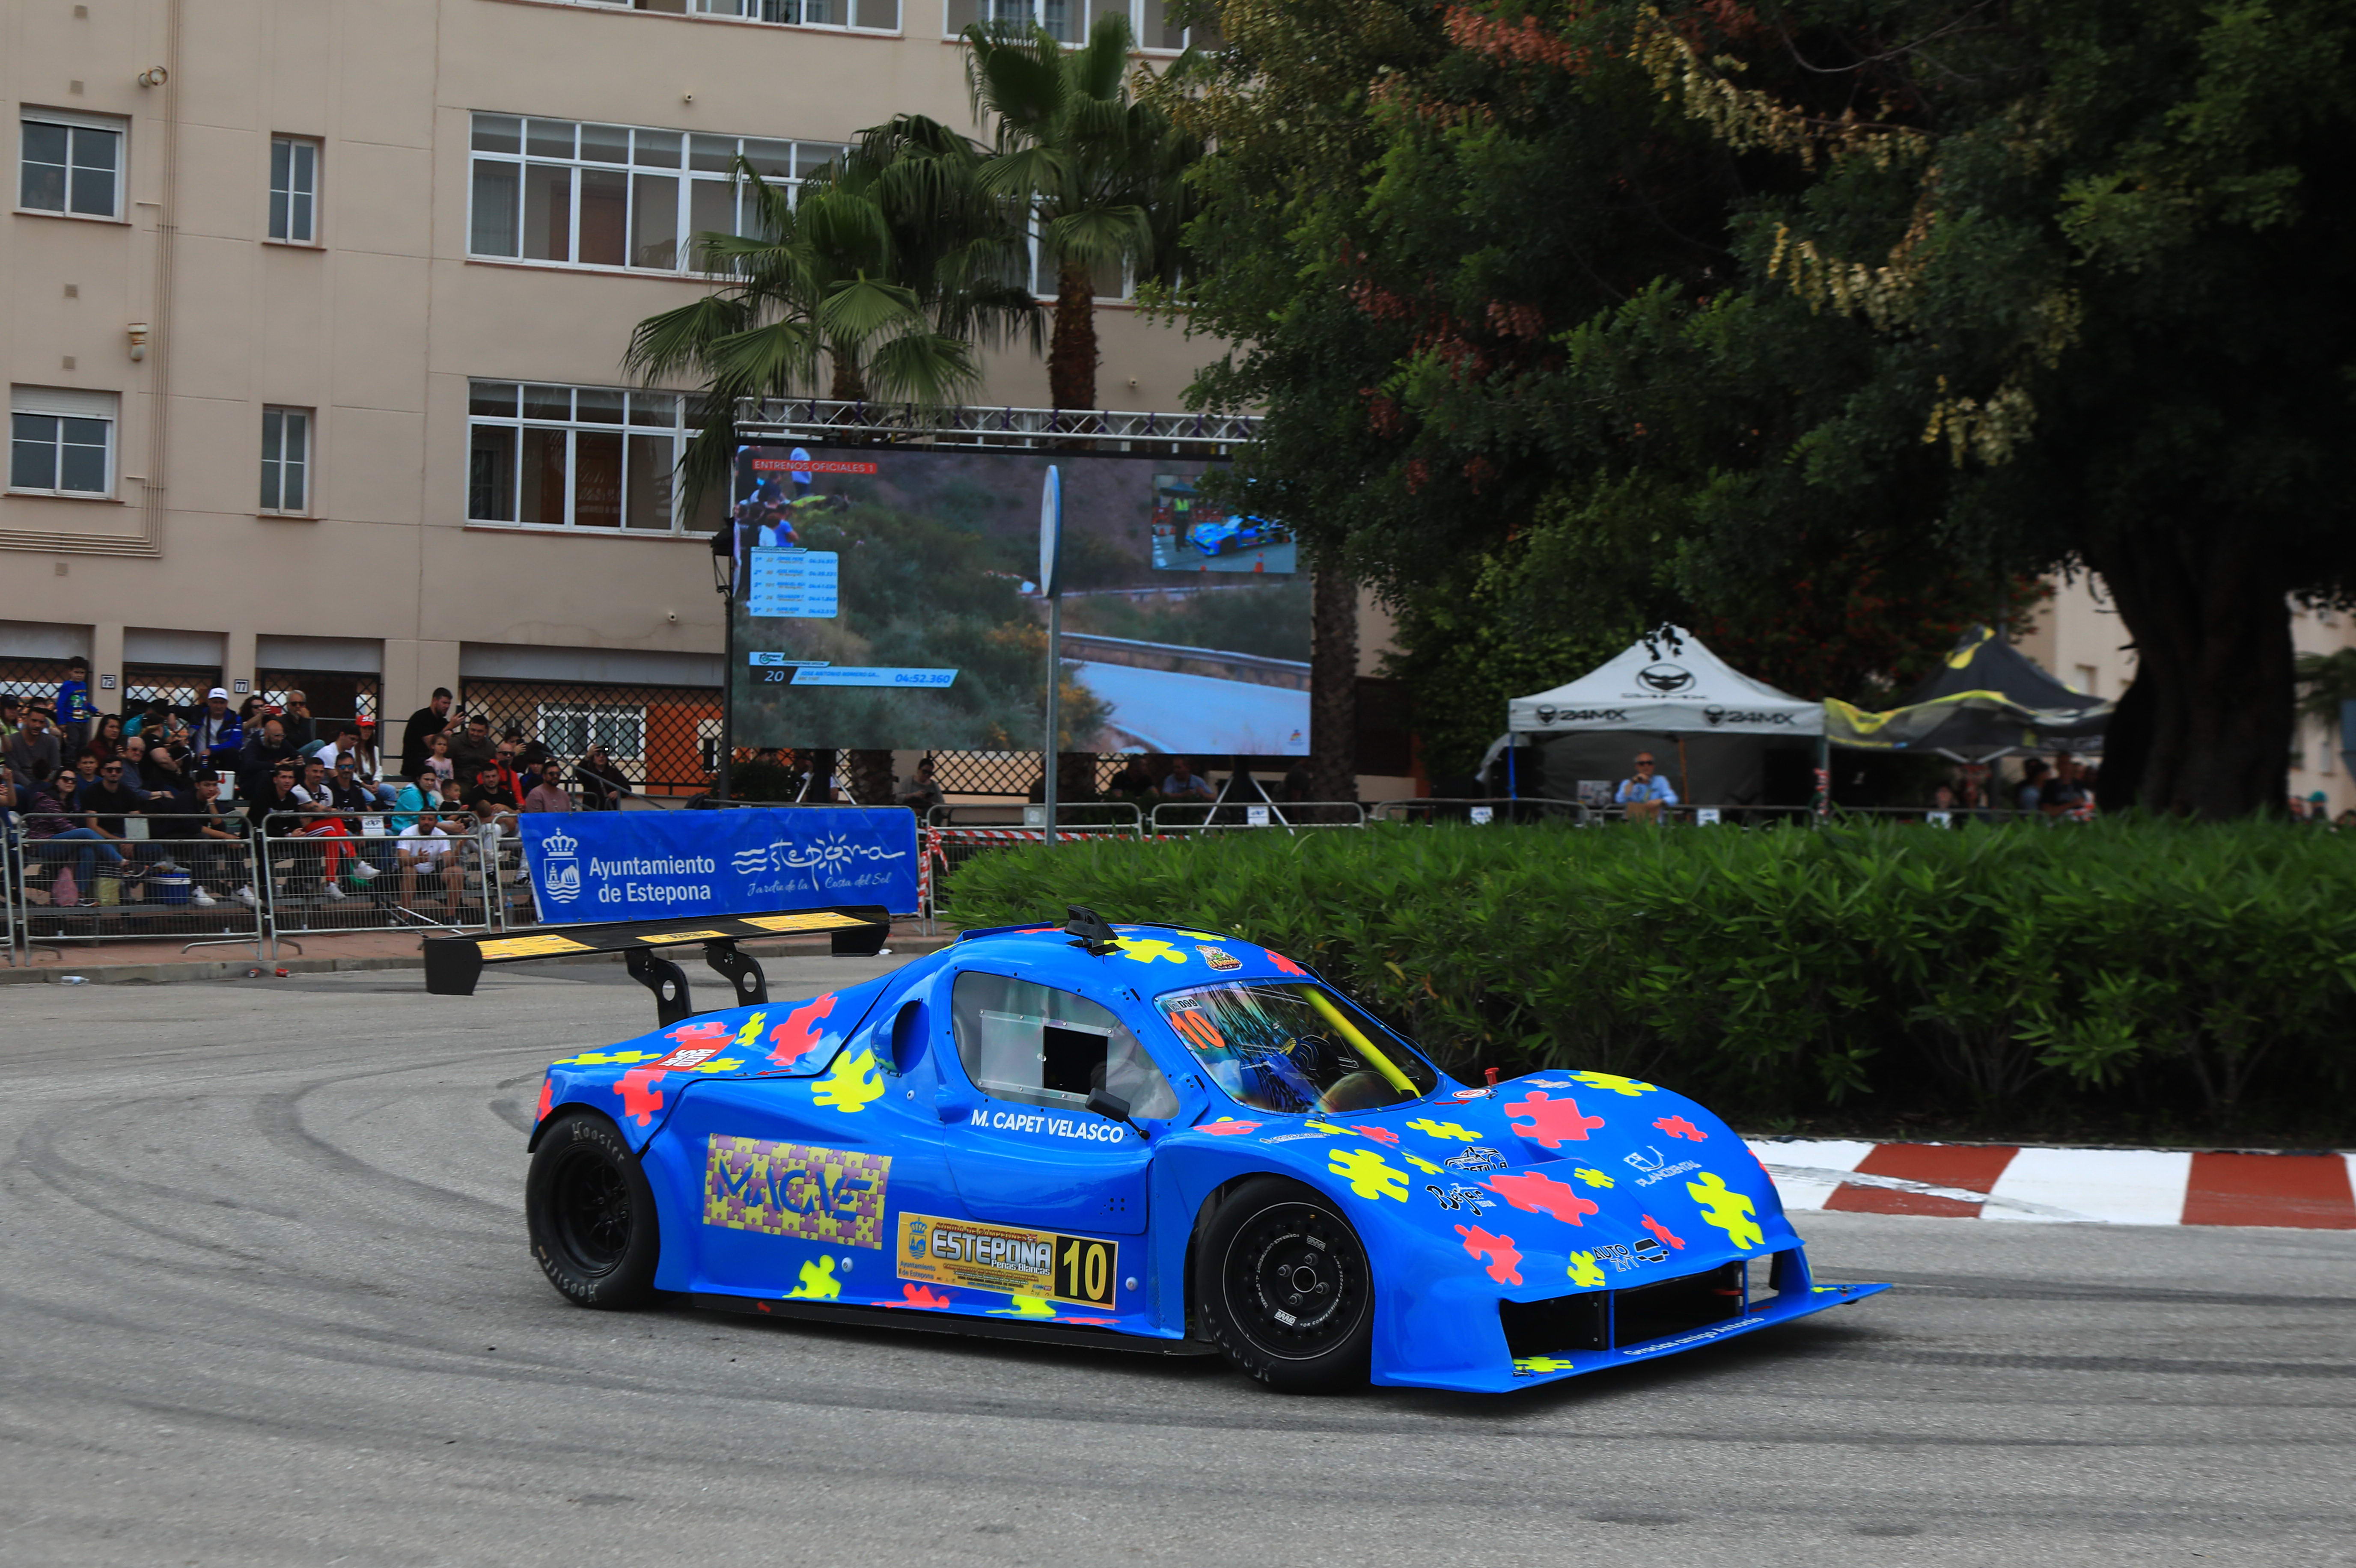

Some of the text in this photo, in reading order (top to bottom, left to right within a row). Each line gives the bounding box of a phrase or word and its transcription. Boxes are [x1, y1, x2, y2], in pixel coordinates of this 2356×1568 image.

[754, 461, 809, 470] ENTRENOS
[812, 462, 865, 472] OFICIALES
[765, 670, 785, 682] 20
[895, 673, 951, 684] 04:52.360
[1559, 709, 1628, 722] 24MX
[1726, 710, 1797, 725] 24MX
[589, 855, 716, 880] Ayuntamiento
[797, 879, 809, 890] la
[825, 876, 851, 888] Costa
[854, 874, 871, 887] del
[872, 872, 892, 885] Sol
[598, 882, 711, 905] de Estepona
[1177, 999, 1198, 1008] D99
[1169, 1010, 1225, 1050] 10
[657, 1049, 698, 1066] SPORT
[672, 1048, 717, 1067] AUTO
[970, 1109, 1124, 1143] M. CAPET VELASCO
[572, 1121, 625, 1161] Hoosier
[935, 1222, 963, 1232] SUBIDA
[966, 1226, 977, 1235] DE
[978, 1229, 1027, 1241] CAMPEONES
[931, 1229, 1052, 1269] ESTEPONA
[1306, 1236, 1326, 1250] BRAID
[1591, 1244, 1630, 1260] AUTO
[900, 1260, 936, 1271] Ayuntamiento
[1017, 1263, 1050, 1276] Blancas
[1063, 1240, 1107, 1301] 10
[1610, 1255, 1640, 1272] ZYT
[910, 1270, 934, 1279] Estepona
[1275, 1310, 1296, 1324] BRAID
[1312, 1298, 1339, 1325] COMPETITION
[1623, 1317, 1765, 1356] Gracias amigo Antonio
